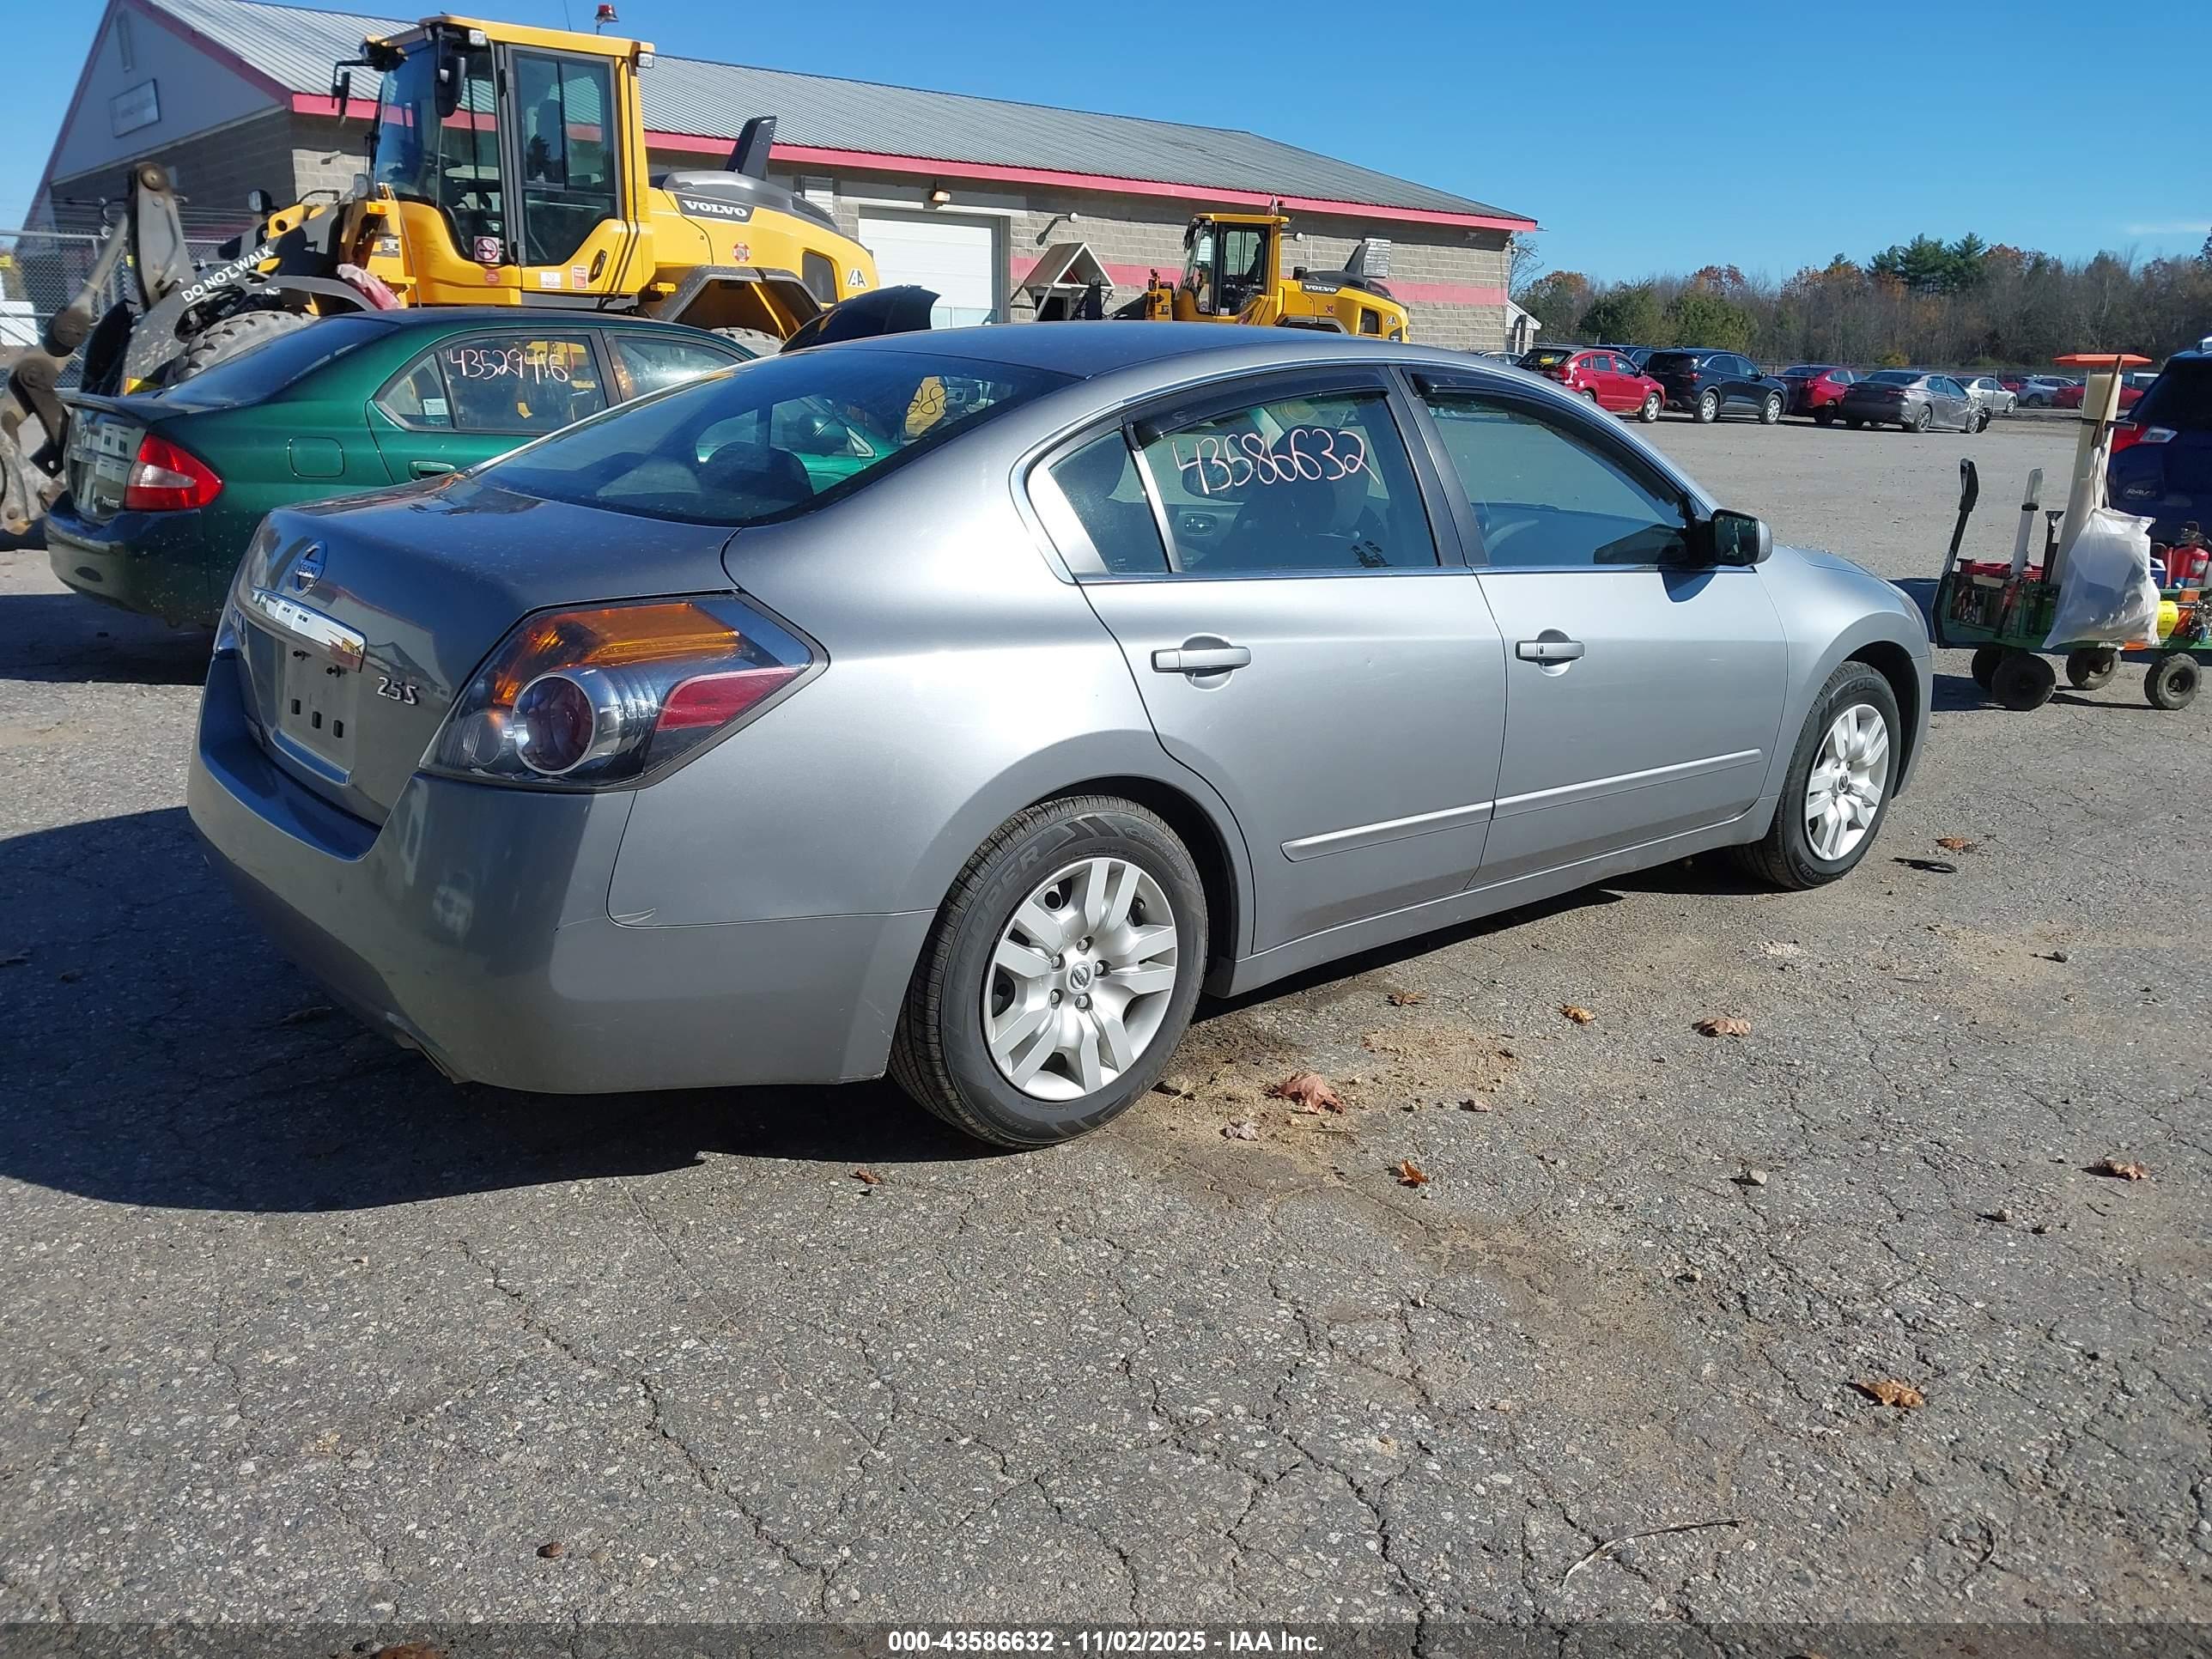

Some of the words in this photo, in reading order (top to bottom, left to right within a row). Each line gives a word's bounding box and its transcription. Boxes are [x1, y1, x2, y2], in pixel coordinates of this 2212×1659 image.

[682, 199, 747, 216] VOLVO
[181, 284, 204, 302] DO
[204, 265, 236, 289] NOT
[233, 246, 275, 272] WALK
[1305, 284, 1337, 293] VOLVO
[447, 348, 568, 385] 43529416
[1172, 428, 1380, 495] 43586632
